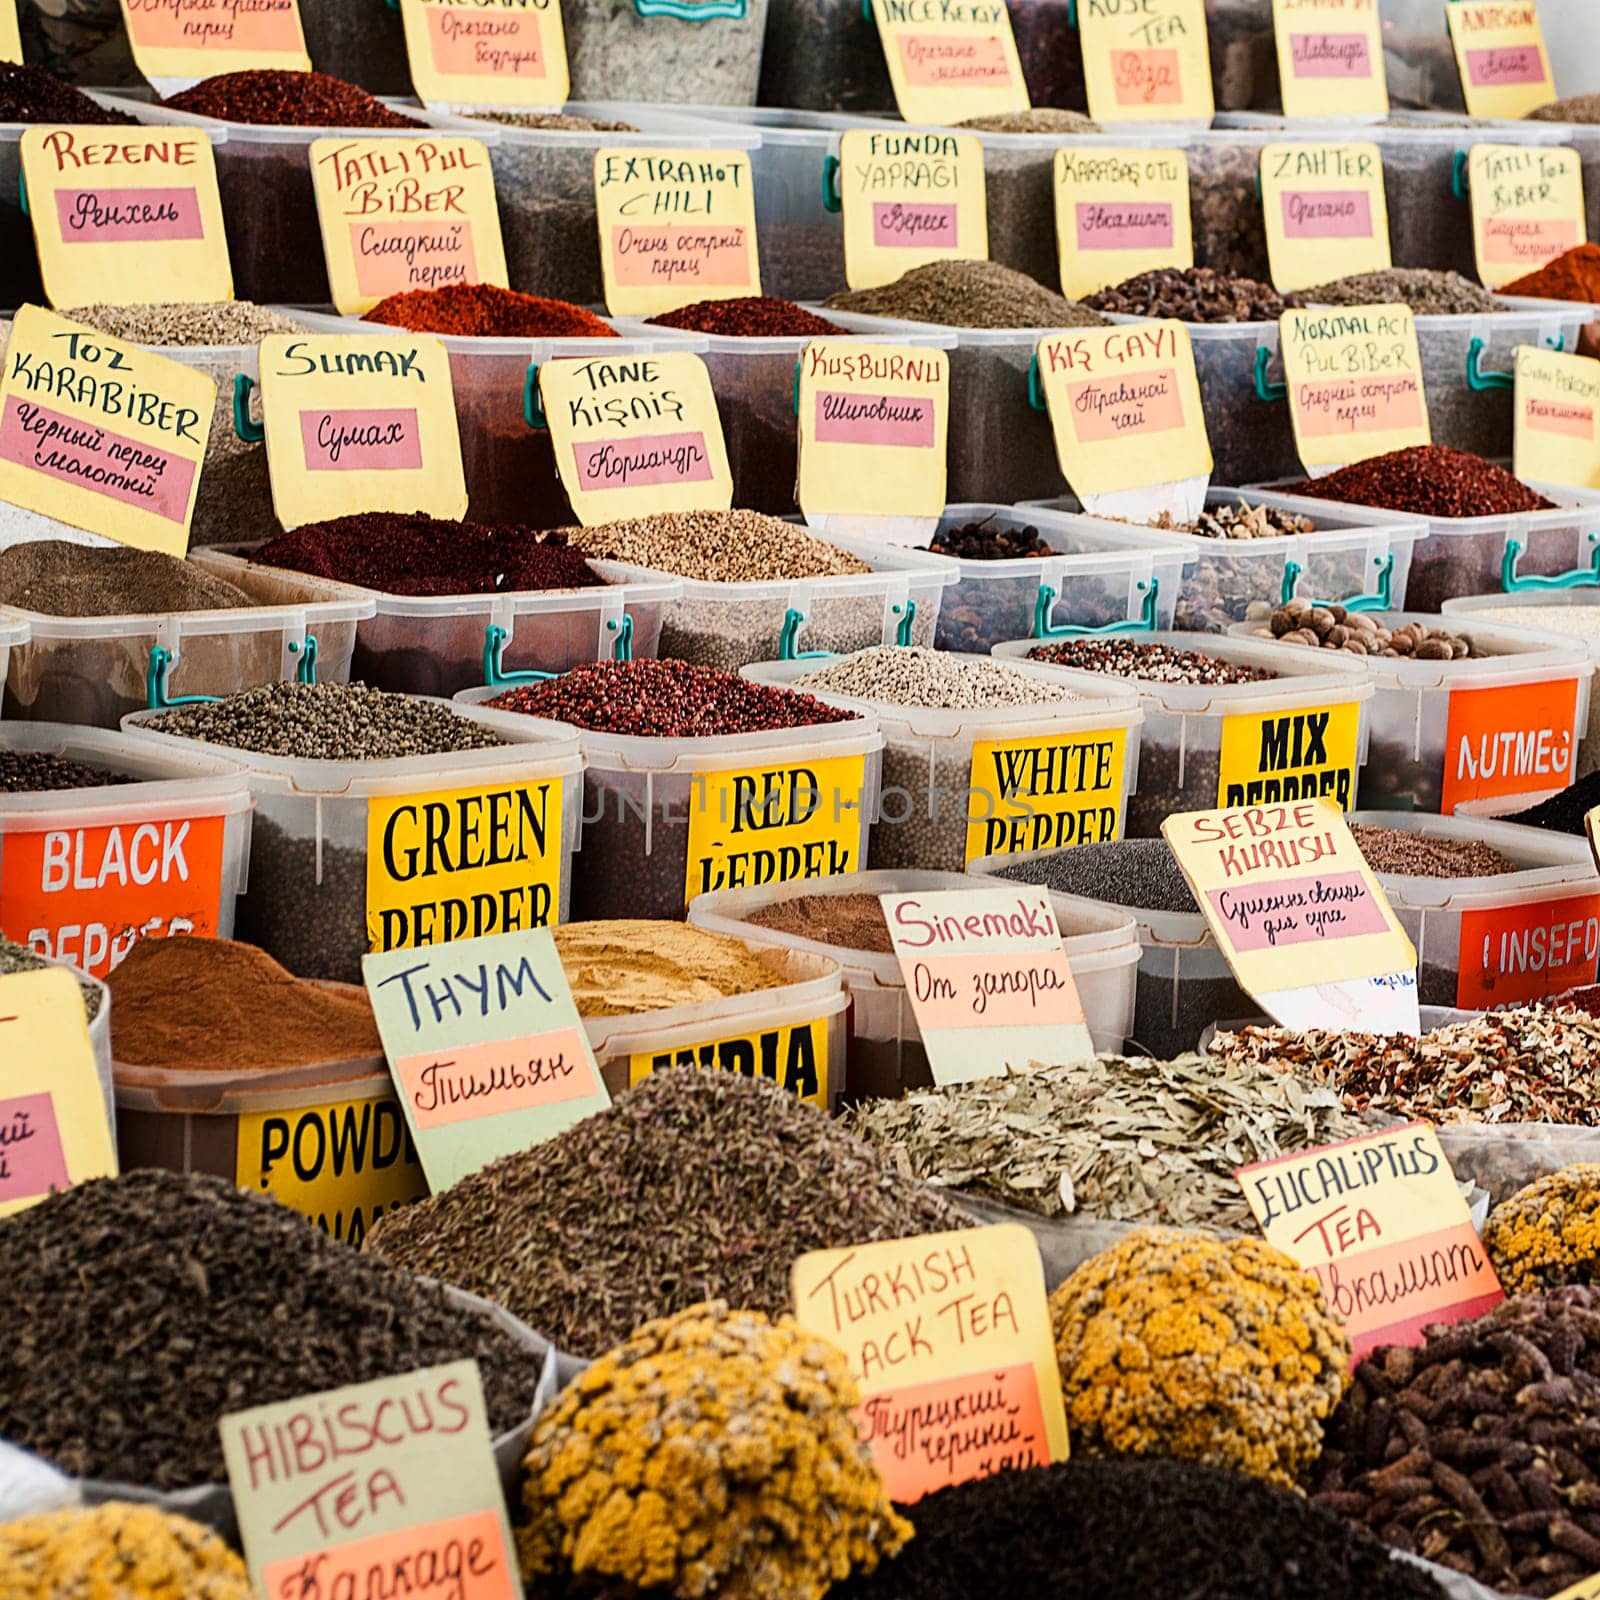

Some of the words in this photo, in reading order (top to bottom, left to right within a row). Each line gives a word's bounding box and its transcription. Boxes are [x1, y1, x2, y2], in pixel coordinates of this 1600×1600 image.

[184, 22, 234, 45] перец
[441, 11, 520, 41] Орегано
[1128, 15, 1188, 47] TEA
[43, 131, 199, 171] REZENE
[871, 134, 959, 157] FUNDA
[1273, 149, 1374, 178] ZAHTER
[318, 143, 410, 192] TATLI
[416, 143, 482, 173] PUL
[856, 160, 958, 192] YAPRAĞI
[1145, 161, 1178, 181] OTU
[69, 193, 179, 229] Фенхель
[619, 190, 712, 216] CHILI
[880, 203, 948, 236] Вереск
[1289, 193, 1355, 225] Орегано
[361, 226, 463, 265] Сладкий
[619, 228, 668, 254] Очень
[409, 264, 467, 288] перец
[652, 258, 700, 281] перец
[1293, 316, 1372, 342] NORMAL
[1377, 316, 1408, 336] ACI
[53, 333, 133, 371] TOZ
[276, 343, 425, 382] SUMAK
[810, 347, 940, 383] KUŞBURNU
[1048, 339, 1094, 373] KIŞ
[1300, 343, 1339, 374] PUL
[573, 361, 660, 390] TANE
[1075, 375, 1168, 415] Травяной
[823, 394, 923, 422] Шиповник
[1111, 403, 1145, 430] чай
[17, 403, 104, 448] Черный
[107, 443, 168, 476] перец
[318, 415, 405, 462] Сумах
[587, 445, 703, 483] Кориандр
[1258, 712, 1330, 773] MIX
[1457, 728, 1570, 781] NUTMEG
[992, 741, 1113, 800] WHITE
[730, 768, 819, 834] RED
[383, 784, 550, 882] GREEN
[1191, 804, 1315, 844] SEBZE
[41, 820, 190, 893] BLACK
[1219, 832, 1337, 878] KURUSU
[895, 899, 1054, 947] Sinemaki
[1263, 917, 1298, 945] для
[1305, 909, 1346, 937] супа
[377, 957, 552, 1031] THYM
[914, 963, 957, 1002] От
[972, 967, 1065, 1014] запора
[415, 1053, 574, 1111] Тимьян
[261, 1101, 418, 1188] POWD
[1293, 1204, 1382, 1257] TEA
[809, 1244, 976, 1333] TURKISH
[857, 1316, 933, 1381] ACK
[937, 1291, 1019, 1344] TEA
[858, 1373, 1008, 1460] Турецкий
[921, 1405, 1021, 1473] черный
[273, 1469, 406, 1539] TEA
[281, 1537, 496, 1600] Каркаде
